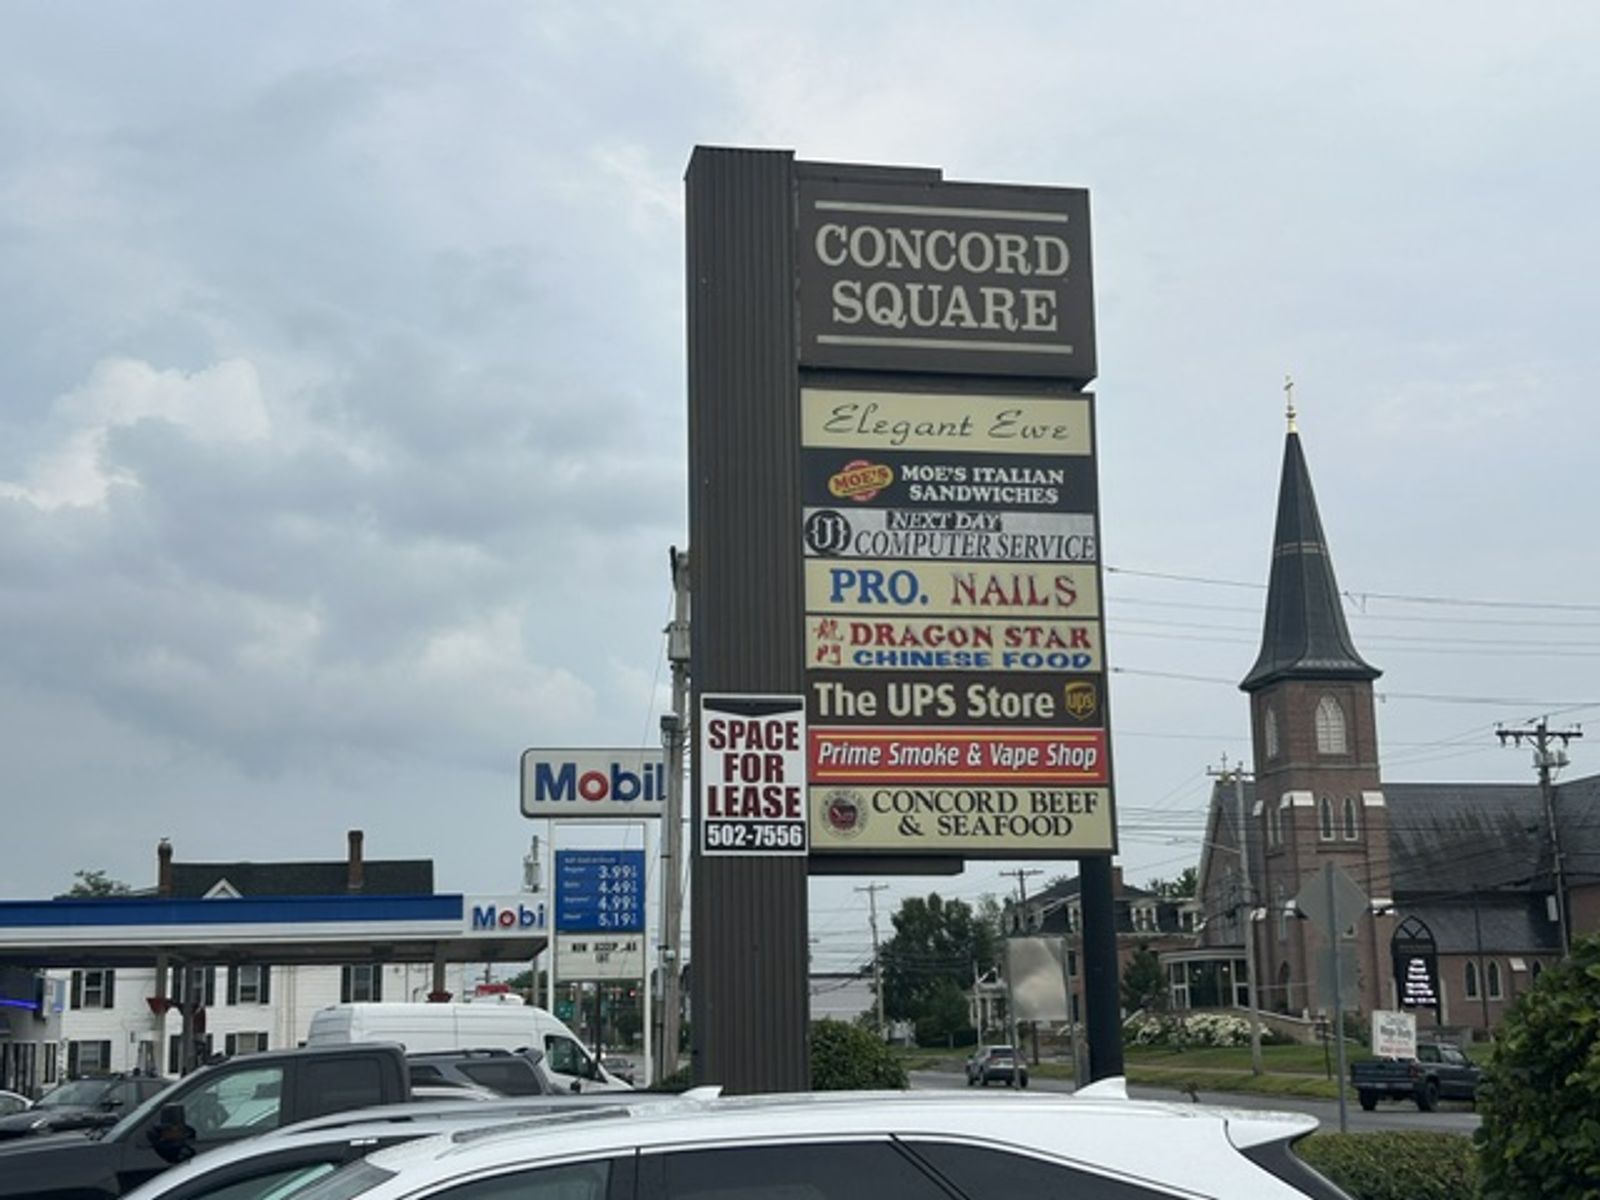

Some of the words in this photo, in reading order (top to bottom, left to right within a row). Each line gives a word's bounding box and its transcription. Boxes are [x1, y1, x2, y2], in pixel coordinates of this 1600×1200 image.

[815, 224, 1070, 276] CONCORD
[832, 280, 1058, 332] SQUARE
[823, 403, 973, 445] Elegant
[987, 409, 1070, 440] Ewe
[834, 468, 890, 491] MOE'S
[901, 464, 967, 482] MOE'S
[972, 467, 1065, 485] ITALIAN
[909, 484, 1059, 504] SANDWICHES
[891, 510, 951, 530] NEXT
[954, 511, 1000, 531] DAY
[854, 530, 991, 557] COMPUTER
[995, 534, 1095, 560] SERVICE
[829, 568, 928, 605] PRO.
[951, 572, 1077, 607] NAILS
[850, 622, 993, 648] DRAGON
[1004, 625, 1092, 650] STAR
[853, 650, 992, 667] CHINESE
[1003, 652, 1092, 668] FOOD
[813, 682, 877, 717] The
[887, 683, 957, 718] UPS
[967, 684, 1055, 719] Store
[708, 720, 799, 750] SPACE
[724, 753, 784, 783] FOR
[818, 742, 881, 766] Prime
[888, 743, 959, 767] Smoke
[967, 743, 982, 767] &
[990, 744, 1039, 771] Vape
[1046, 744, 1097, 771] Shop
[535, 762, 667, 802] Mobil
[708, 785, 801, 818] LEASE
[872, 790, 1019, 814] CONCORD
[1029, 791, 1099, 814] BEEF
[707, 824, 802, 847] 502-7556
[898, 815, 924, 837] &
[937, 815, 1073, 837] SEAFOOD
[472, 904, 545, 931] Mobi
